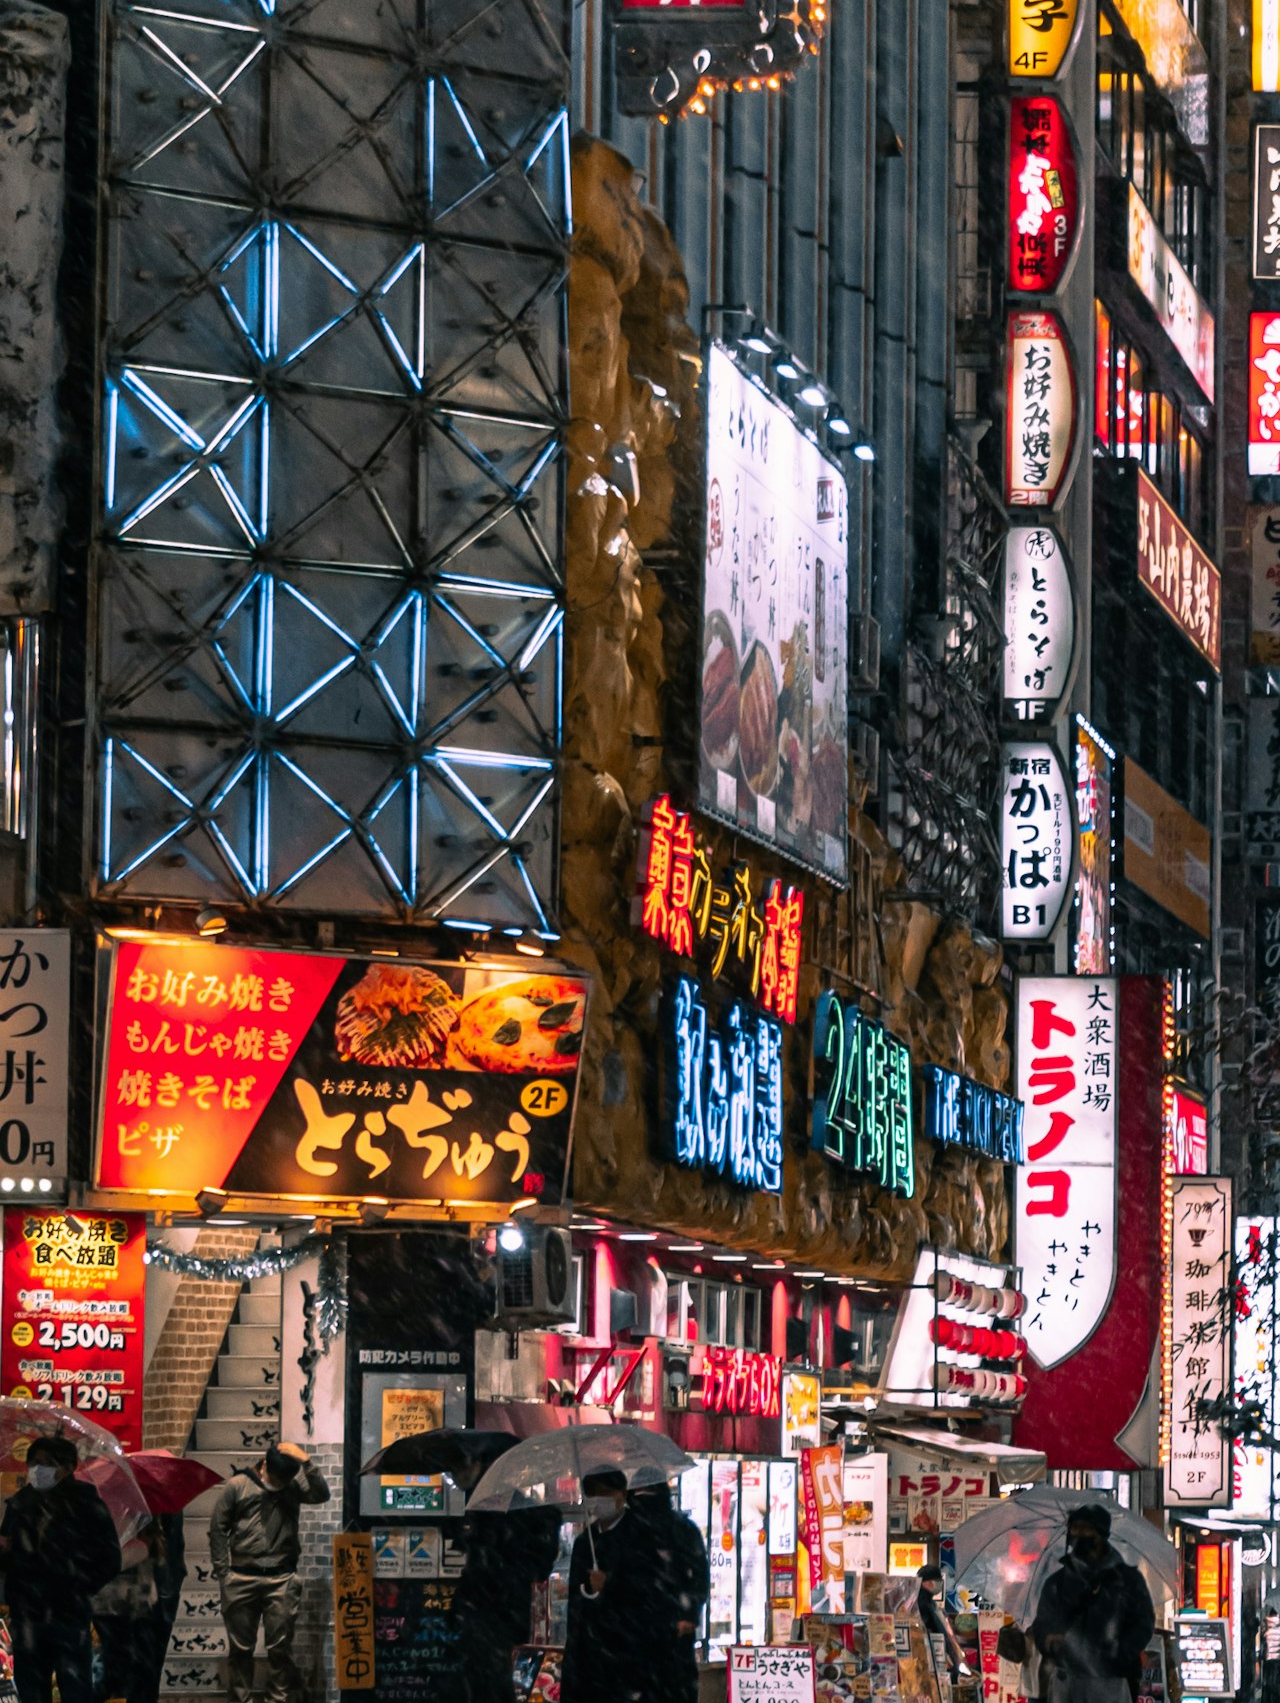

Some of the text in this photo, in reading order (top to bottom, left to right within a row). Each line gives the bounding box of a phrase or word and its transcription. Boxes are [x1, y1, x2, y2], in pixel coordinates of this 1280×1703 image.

[1015, 52, 1049, 69] 4F
[1054, 214, 1067, 257] 3F
[1022, 344, 1052, 486] お好み焼き
[1028, 532, 1052, 558] 虎
[1028, 567, 1053, 691] とらそば
[1015, 700, 1046, 720] 1F
[1009, 758, 1051, 776] 新宿
[1008, 779, 1053, 890] かっぱ
[1012, 905, 1047, 926] B1
[127, 968, 295, 1013] お好み焼き
[126, 1022, 293, 1062] もんじゃ焼き
[1082, 984, 1113, 1112] 大衆酒場
[118, 1071, 258, 1111] 焼きそば
[322, 1078, 409, 1100] お好み焼き
[529, 1087, 562, 1109] 2F
[823, 995, 914, 1200] 24時間
[1026, 999, 1076, 1218] トラノコ
[118, 1123, 184, 1160] ピザ
[294, 1077, 533, 1183] とらぢゅう
[35, 1242, 117, 1267] 食べ放題
[1064, 1219, 1102, 1313] やきとり
[1028, 1238, 1069, 1332] やきとん
[38, 1321, 124, 1351] 2,500円
[359, 1349, 461, 1365] 防犯カメラ作動中
[1200, 1451, 1222, 1460] 1953
[899, 1474, 985, 1497] トラノコ
[1187, 1471, 1207, 1484] 2F
[337, 1586, 372, 1684] 営業中
[734, 1654, 755, 1668] 7F
[757, 1659, 811, 1679] うさぎや
